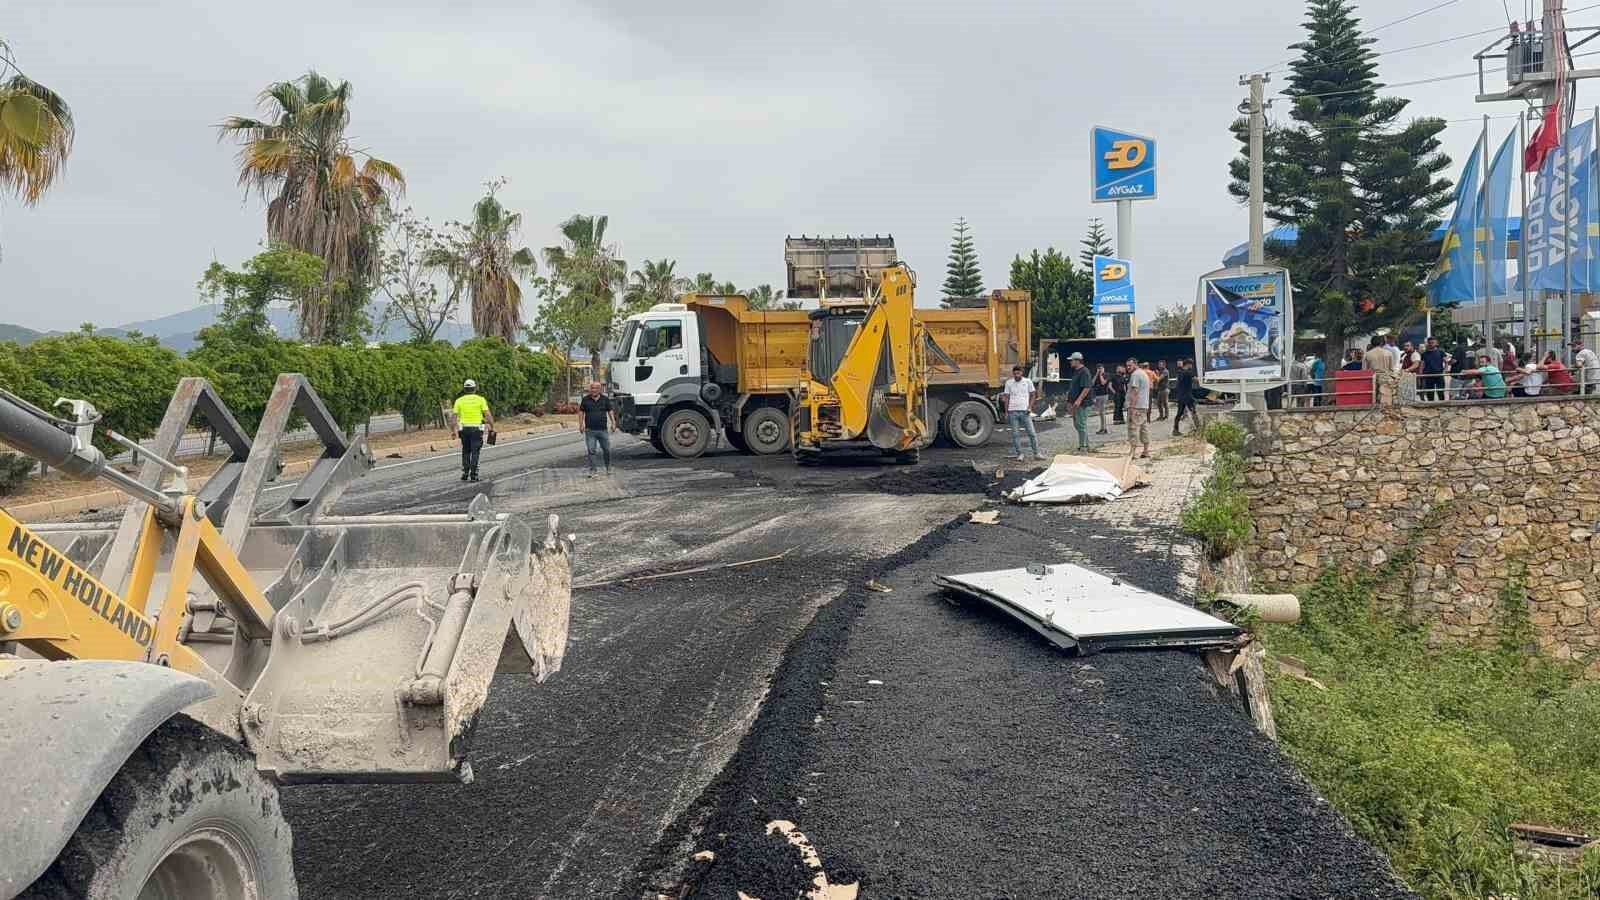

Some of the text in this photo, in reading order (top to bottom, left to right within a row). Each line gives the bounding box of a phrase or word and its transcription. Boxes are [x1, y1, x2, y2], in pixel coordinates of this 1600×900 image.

[1108, 184, 1144, 196] AYGAZ
[1101, 295, 1129, 304] AYGAZ
[8, 526, 151, 647] NEW HOLLAND
